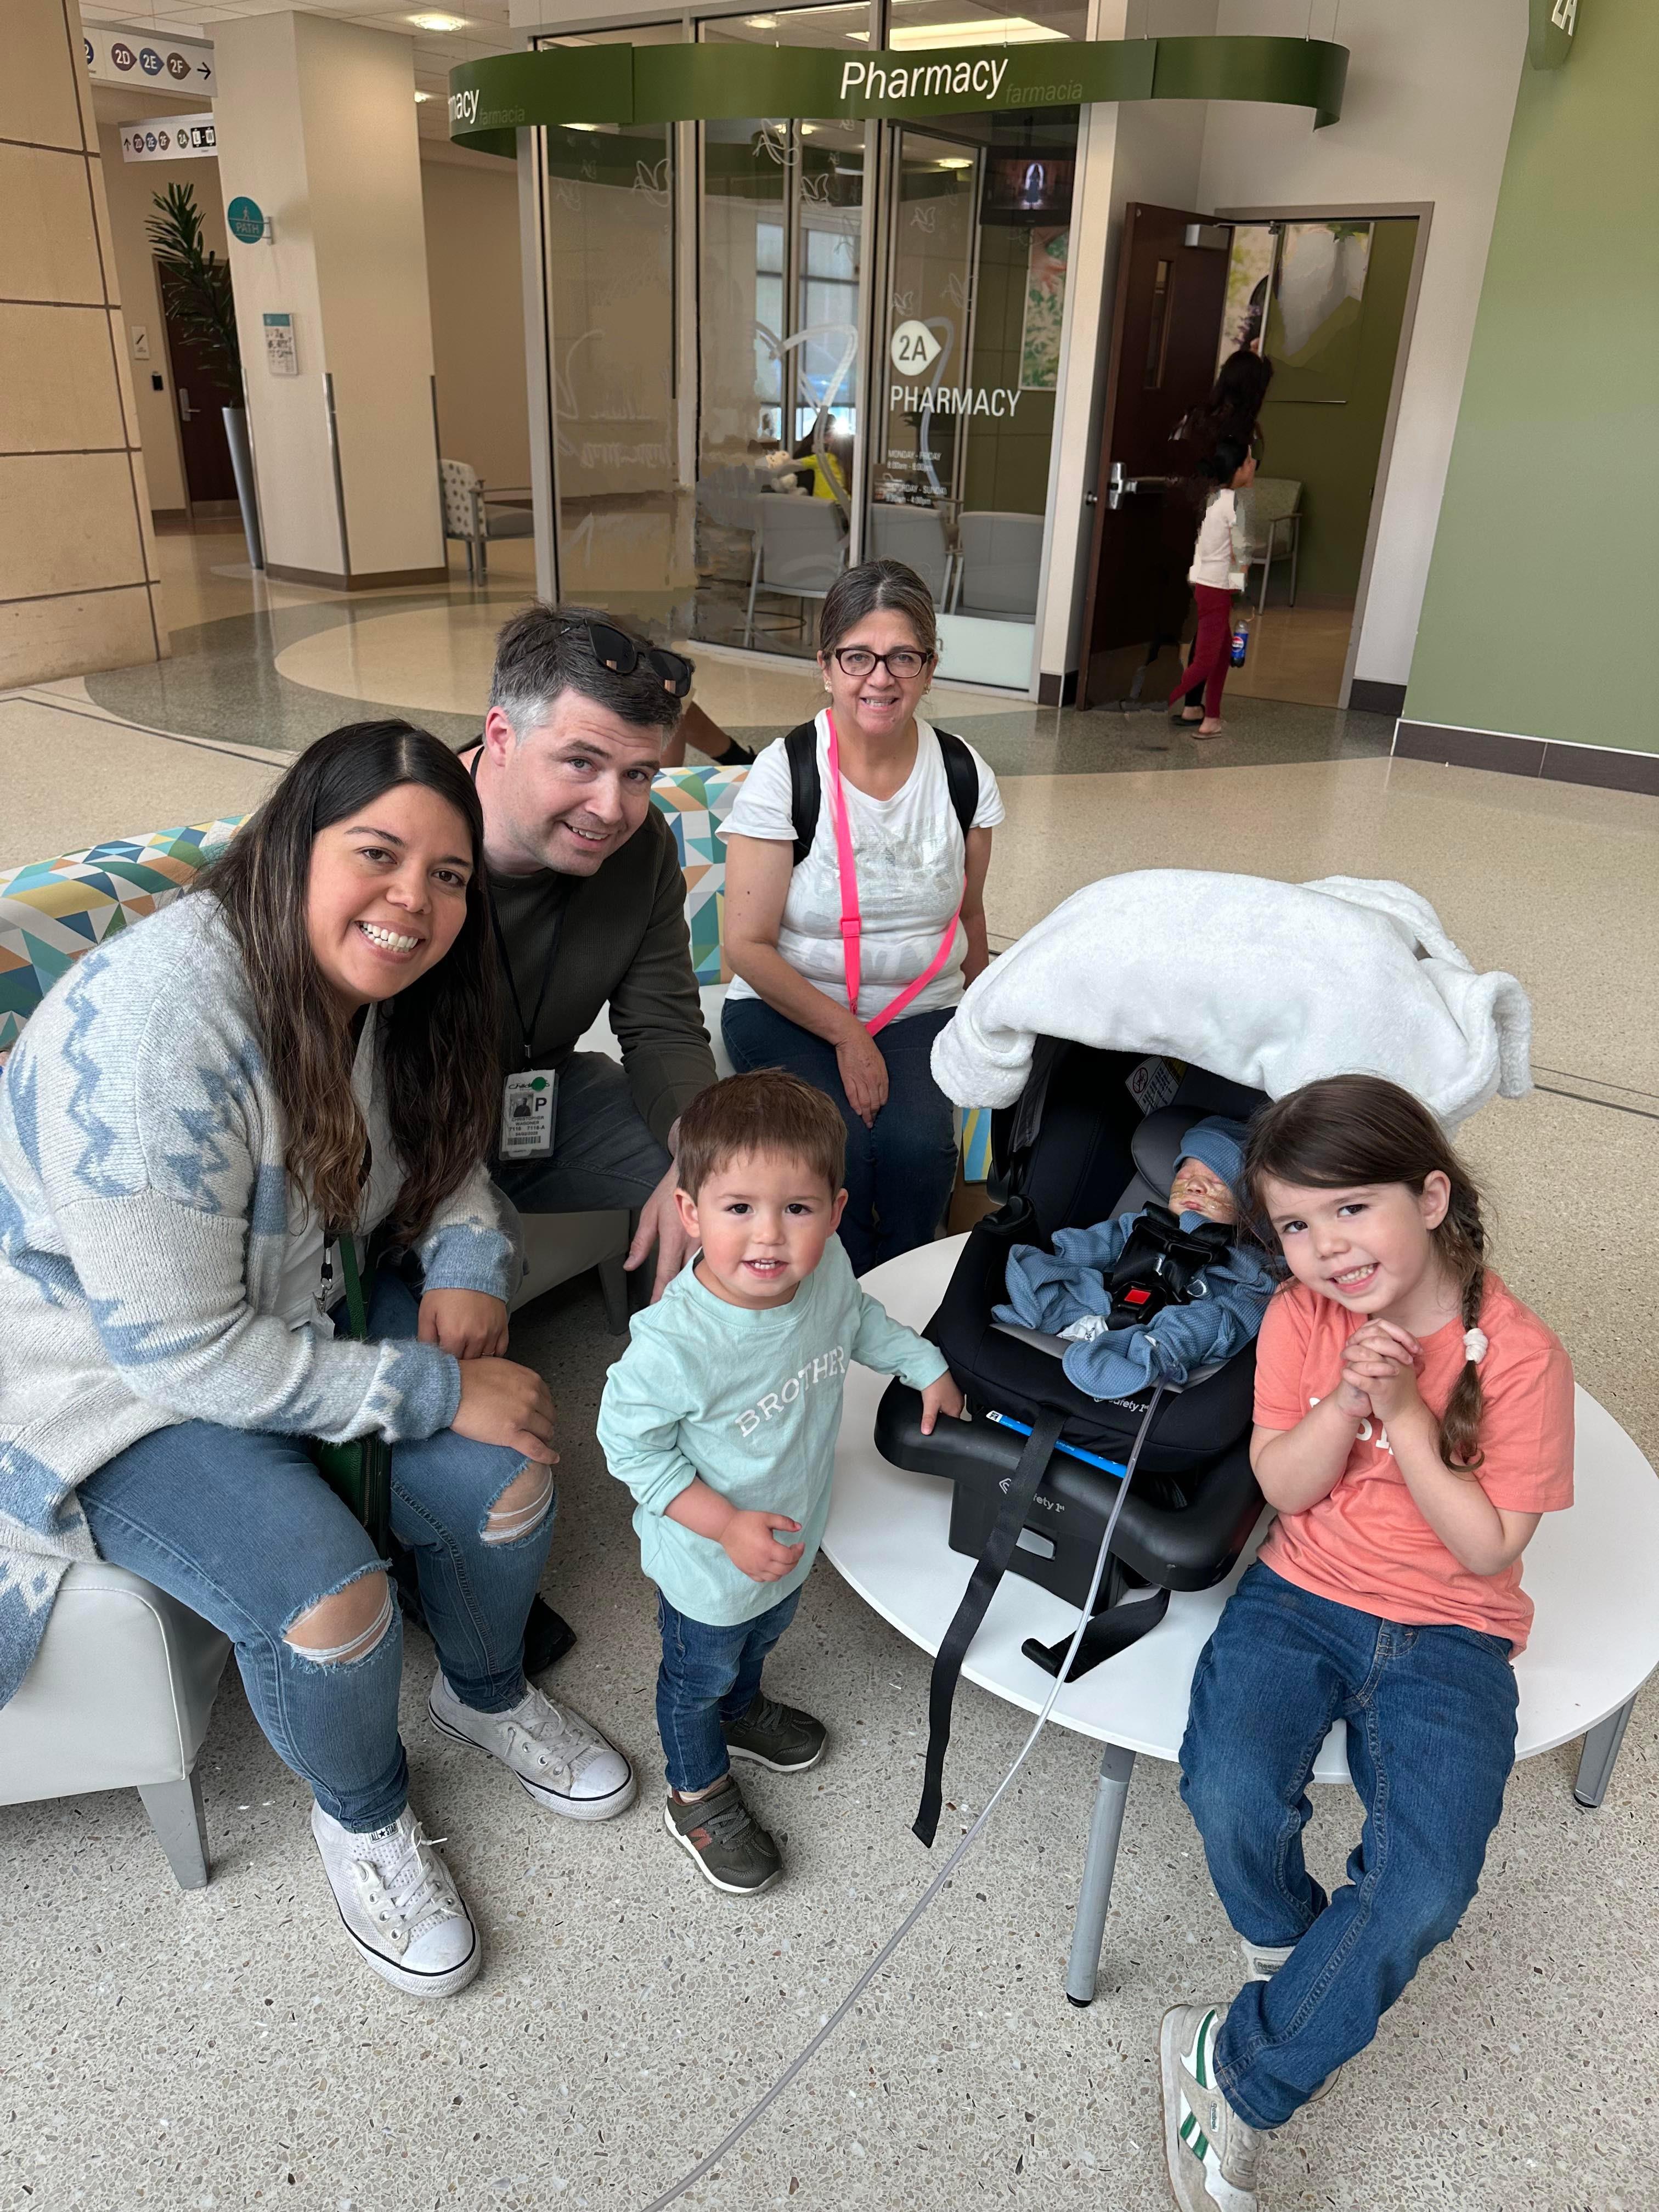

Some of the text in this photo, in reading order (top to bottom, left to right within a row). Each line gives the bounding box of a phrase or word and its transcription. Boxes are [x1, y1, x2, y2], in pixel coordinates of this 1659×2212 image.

[115, 50, 183, 74] 2D 2E 2F
[840, 59, 1083, 104] Pharmacy farmacia
[448, 89, 525, 126] macy farmacia
[148, 137, 155, 148] 2E
[160, 136, 167, 146] 2F
[178, 134, 187, 144] 2A
[236, 222, 259, 234] PATH
[899, 335, 927, 362] 2A
[890, 386, 1022, 417] PHARMACY
[888, 450, 915, 459] MONDAY
[919, 452, 942, 461] FRIDAY
[535, 1097, 547, 1112] P
[735, 1346, 845, 1437] BROTHER
[1033, 1493, 1054, 1510] fety
[371, 1822, 397, 1841] ALL STAR
[1257, 1962, 1282, 1970] Reebo
